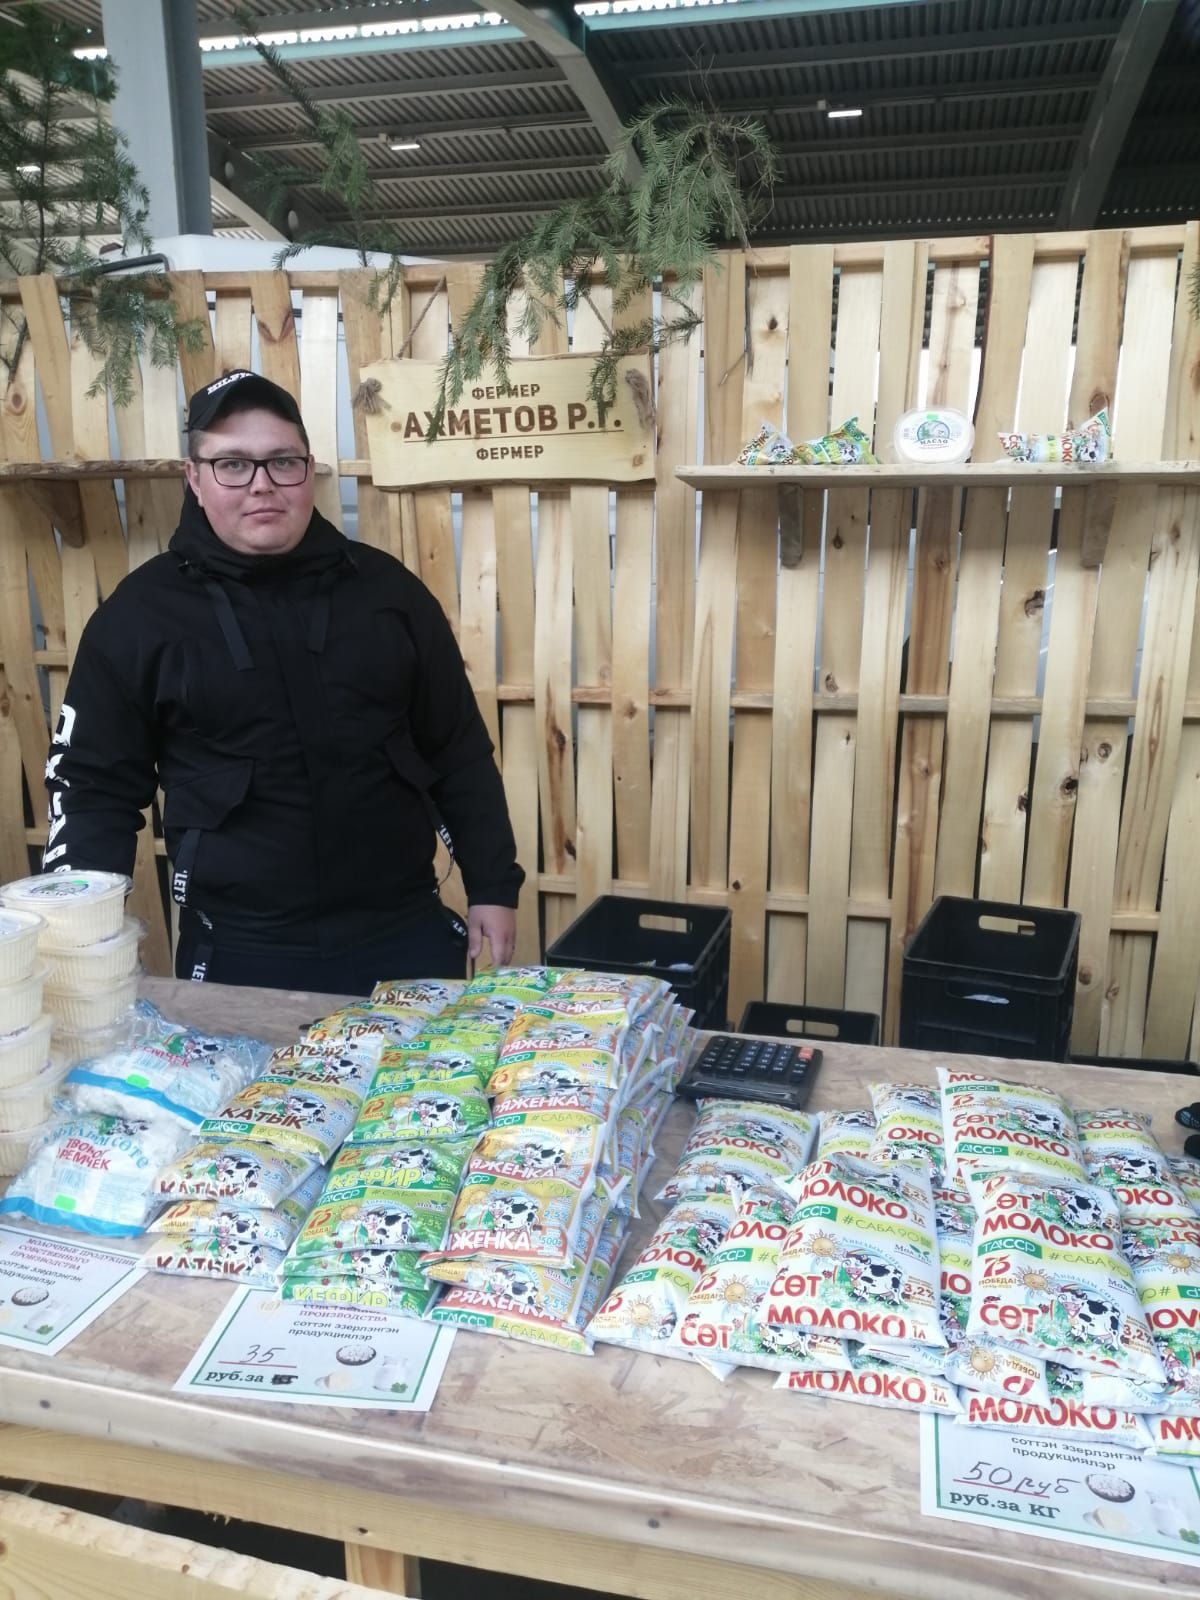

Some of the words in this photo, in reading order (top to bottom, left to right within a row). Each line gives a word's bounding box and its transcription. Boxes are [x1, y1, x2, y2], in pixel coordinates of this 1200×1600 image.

[472, 383, 541, 400] ФЕРМЕР
[403, 404, 558, 439] АХМЕТОВ
[476, 445, 544, 461] ФЕРМЕР
[501, 1038, 586, 1056] РЯЖЕНКА
[219, 1107, 309, 1130] КАТЫК
[496, 1114, 521, 1126] ССР
[953, 1113, 998, 1128] СӨТ
[687, 1136, 782, 1160] МОЛОКО
[954, 1125, 1070, 1158] МОЛОКО
[328, 1166, 423, 1191] КЕФИР
[466, 1175, 491, 1186] ССР
[470, 1159, 556, 1179] ЯЖЕНКА
[794, 1205, 832, 1222] ССР
[447, 1230, 531, 1251] ЖЕНКА
[982, 1212, 1115, 1251] МОЛОКО
[157, 1255, 246, 1275] КАТЫК
[635, 1247, 708, 1274] ОЛОК
[713, 1249, 747, 1265] ССР
[983, 1254, 1012, 1278] 75
[1049, 1252, 1131, 1278] #САБА90
[624, 1270, 653, 1283] ССР
[769, 1274, 823, 1298] СӨТ
[291, 1285, 390, 1308] КЕФИР
[904, 1282, 935, 1299] 3,2%
[299, 1310, 388, 1322] ПРОИЗВОДСТВА
[446, 1287, 559, 1322] РЯЖЕНКА
[767, 1303, 907, 1339] МОЛОКО
[979, 1303, 1039, 1334] СӨТ
[680, 1322, 733, 1349] СӨТ
[239, 1344, 286, 1364] 35
[205, 1369, 264, 1384] руб.за
[788, 1370, 927, 1404] МОЛОКО
[968, 1396, 1117, 1431] МОЛОКО
[949, 1490, 1021, 1513] руб.за
[1029, 1504, 1061, 1519] КГ
